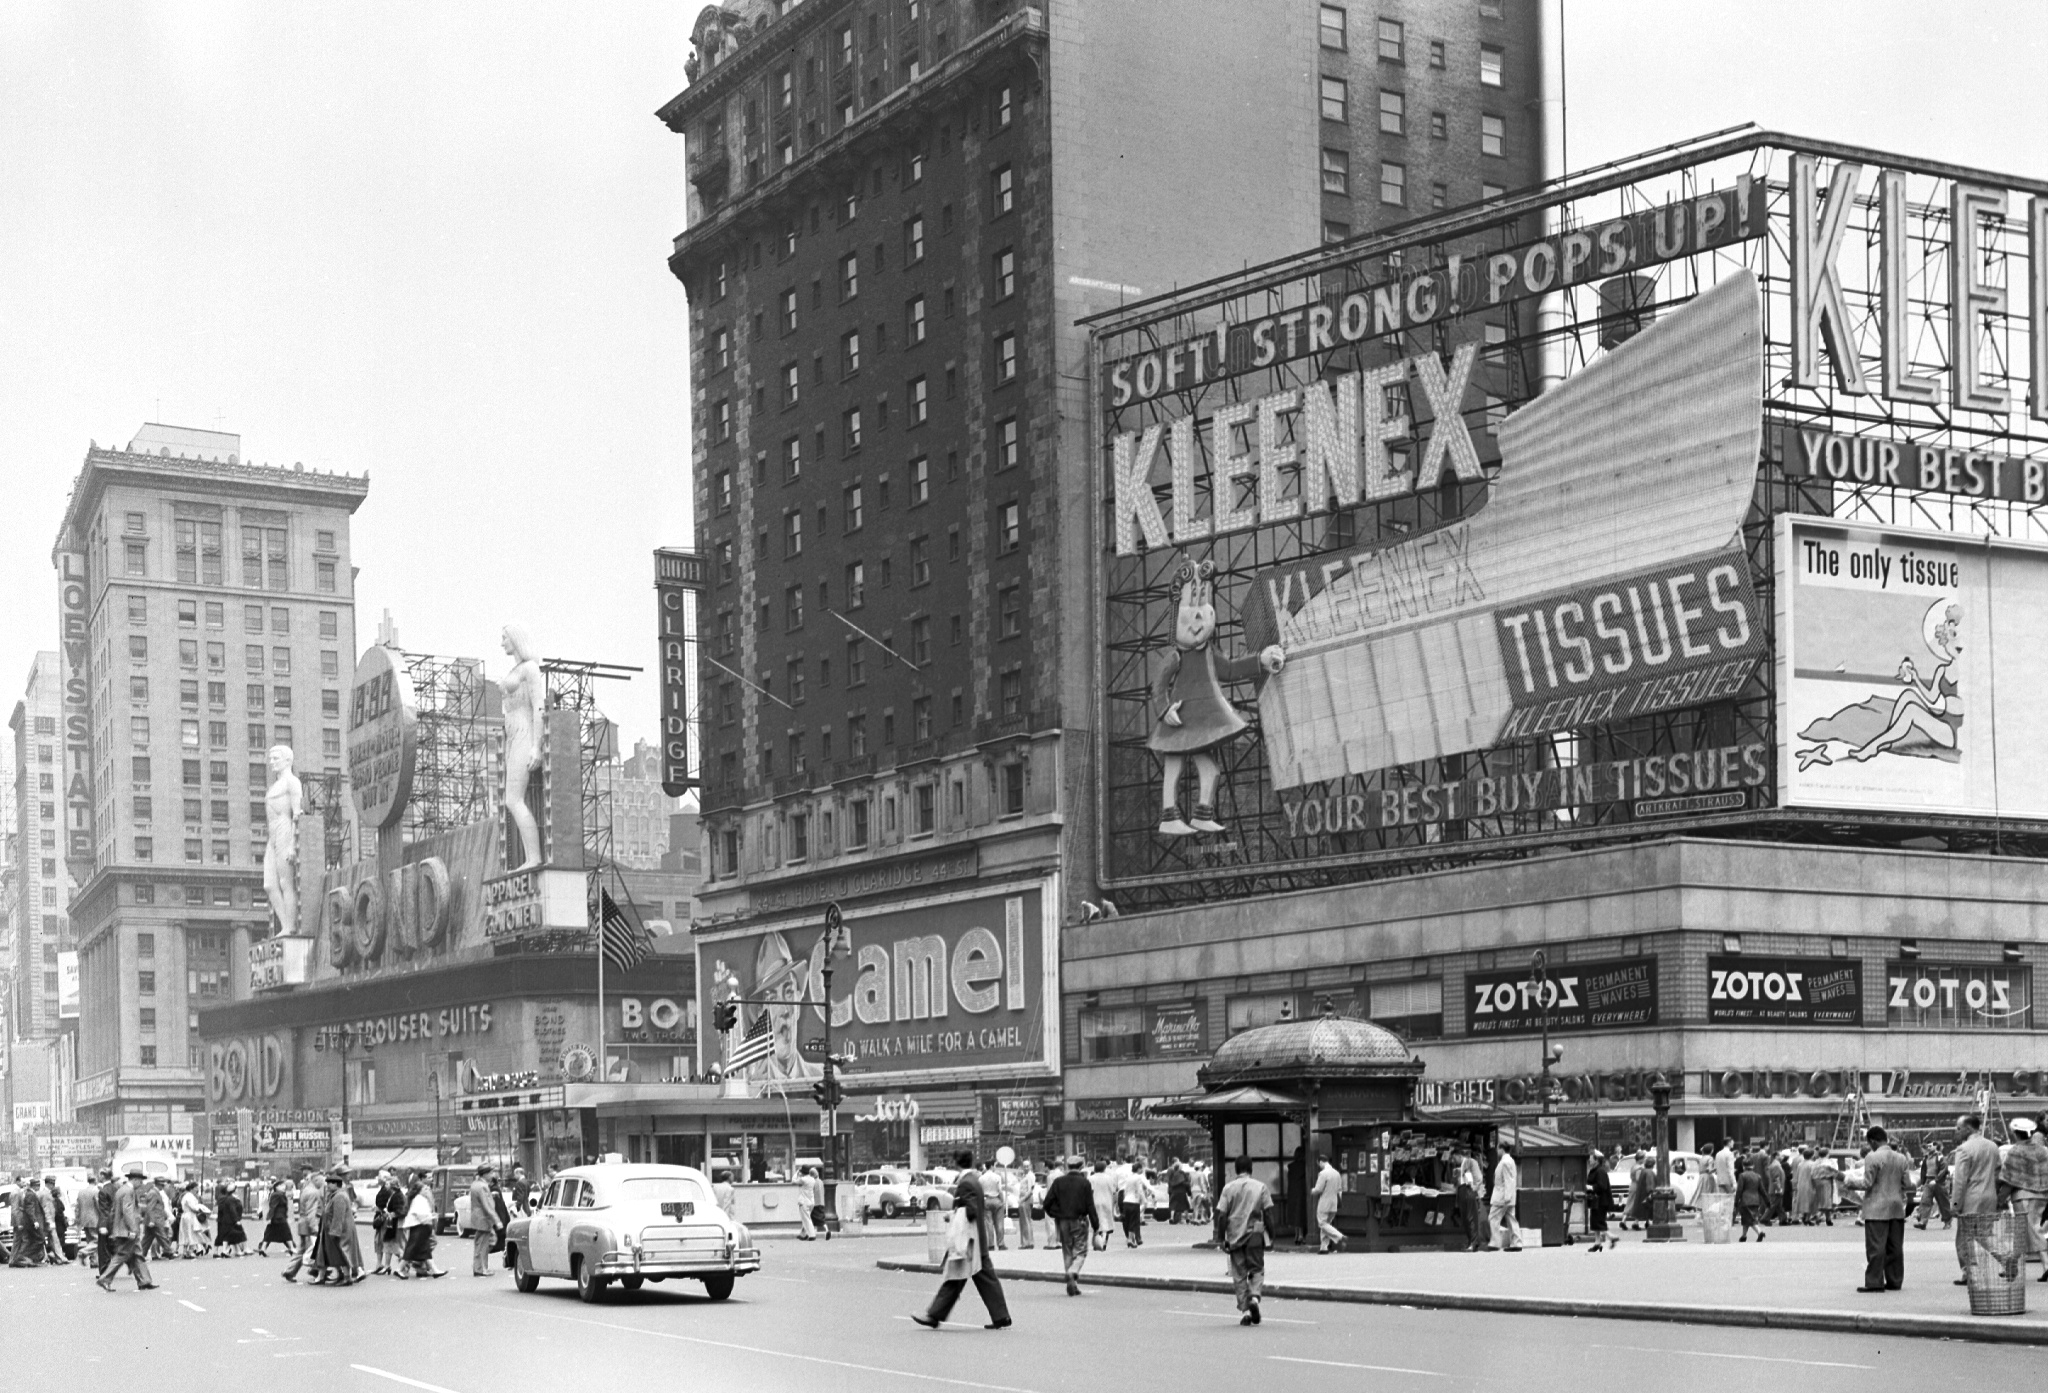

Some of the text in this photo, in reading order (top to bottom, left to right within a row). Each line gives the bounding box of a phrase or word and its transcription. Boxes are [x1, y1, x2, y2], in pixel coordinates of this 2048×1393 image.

[1112, 173, 1754, 407] SOFT! STRONG! POPS UP!
[1112, 341, 1485, 557] KLEENEX
[1803, 430, 1900, 486] YOUR
[1919, 446, 2007, 498] BEST
[1803, 540, 1958, 589] The only tissue
[62, 554, 89, 706] LOEW'S
[1503, 564, 1752, 693] TISSUES
[663, 592, 686, 785] CLARIDGE
[1503, 659, 1756, 741] KLEENEX TISSUES
[1283, 743, 1767, 838] YOUR BEST BUY IN TISSUES
[794, 880, 834, 905] HOTEL
[853, 861, 922, 894] CLARIDGE
[808, 896, 1025, 1028] Camel
[1585, 965, 1649, 990] PERMANENT
[1807, 968, 1855, 989] PERMANENT
[1600, 985, 1638, 1006] WAVES
[1820, 985, 1846, 1003] WAVES
[356, 1012, 432, 1045] TROUSER
[438, 1003, 493, 1036] SUITS
[535, 1014, 565, 1025] BOND
[1472, 1019, 1497, 1031] WORLD'S
[1534, 1016, 1559, 1028] BEUTY
[1560, 1014, 1586, 1026] SALONS
[1591, 1006, 1653, 1024] EVERYWHERE!
[1766, 1009, 1786, 1019] BEAUTY
[1788, 1010, 1808, 1019] SALONS
[1813, 1008, 1856, 1021] EVERYWHERE!
[625, 1031, 648, 1040] TWO
[859, 1037, 891, 1059] WALK
[894, 1038, 903, 1058] A
[907, 1036, 933, 1056] MILE
[938, 1033, 962, 1052] FOR
[966, 1031, 975, 1050] A
[980, 1027, 1022, 1048] CAMEL
[210, 1034, 284, 1102] BOND
[1453, 1079, 1495, 1105] GIFTS
[15, 1106, 37, 1120] GRAND
[258, 1110, 324, 1122] CRITERION
[728, 1116, 756, 1124] POLICE
[277, 1140, 331, 1148] FRENCH LINE
[278, 1131, 331, 1140] JANE RUSSELL
